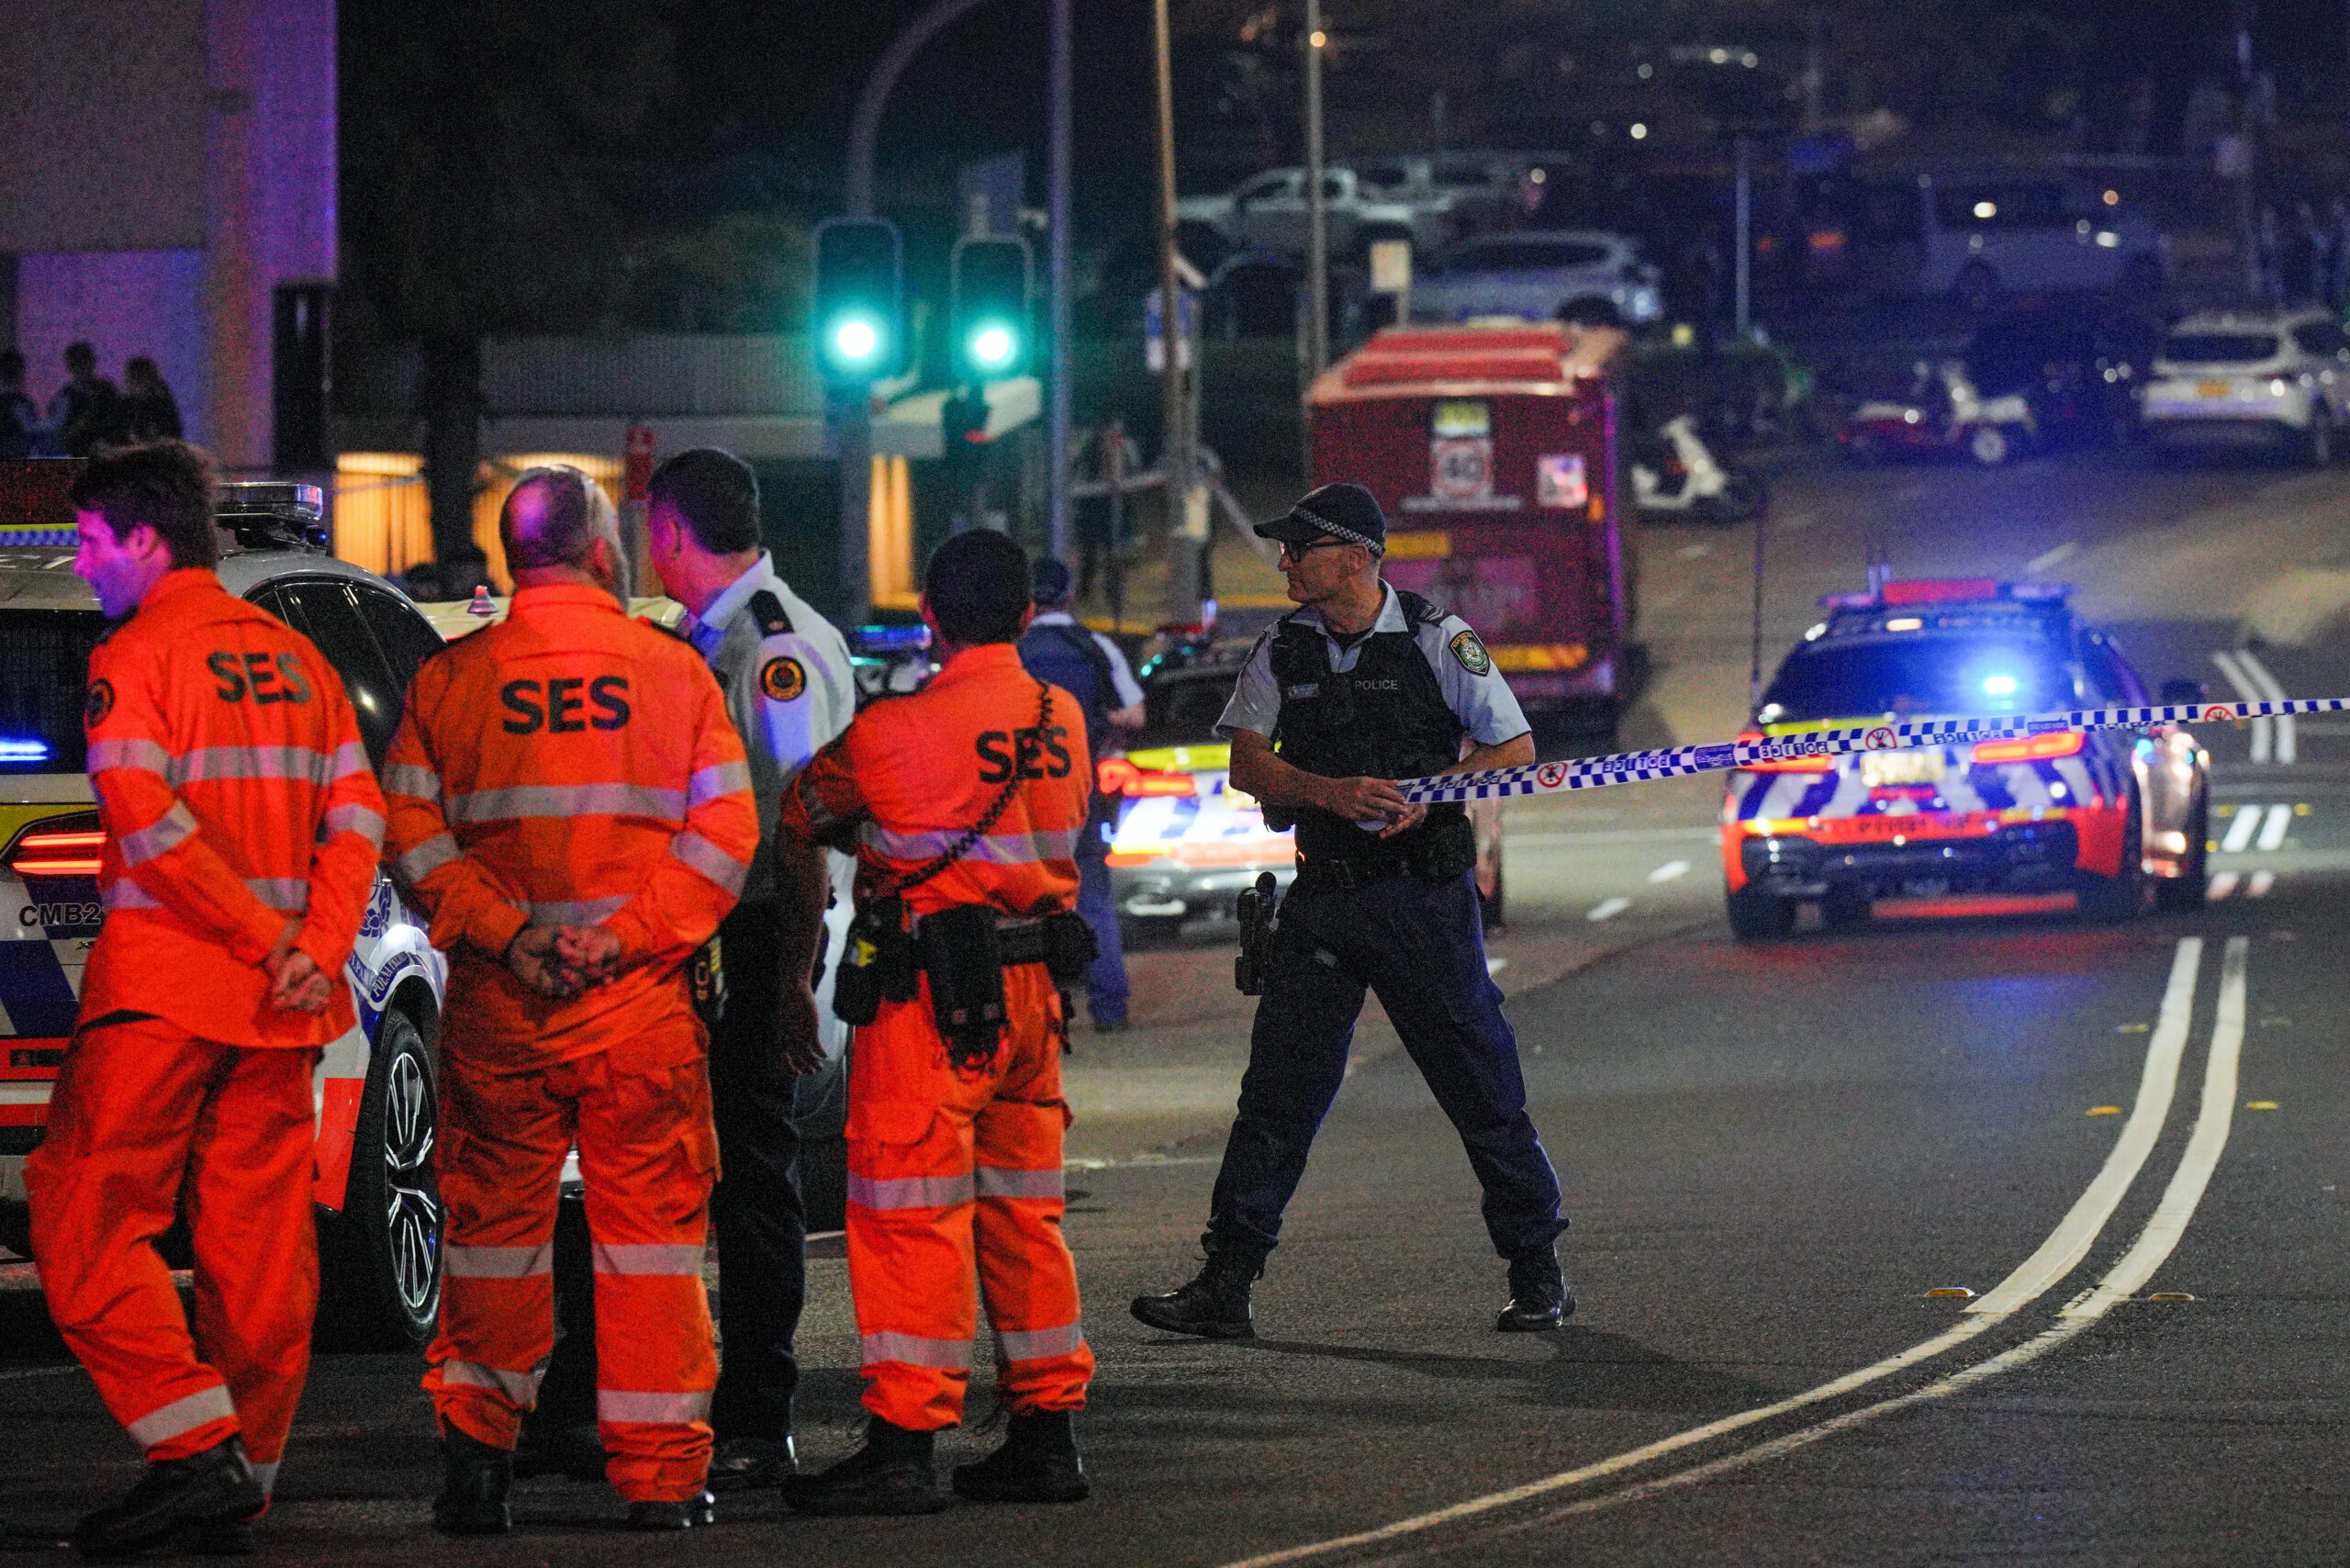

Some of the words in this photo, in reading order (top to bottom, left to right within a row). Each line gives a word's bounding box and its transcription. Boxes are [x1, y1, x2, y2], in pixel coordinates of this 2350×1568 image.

[208, 652, 311, 704] SES
[1354, 679, 1399, 690] POLICE
[500, 677, 631, 734] SES
[976, 726, 1071, 783] SES
[1603, 756, 1668, 773] POLICE
[1761, 741, 1828, 757] POLICE
